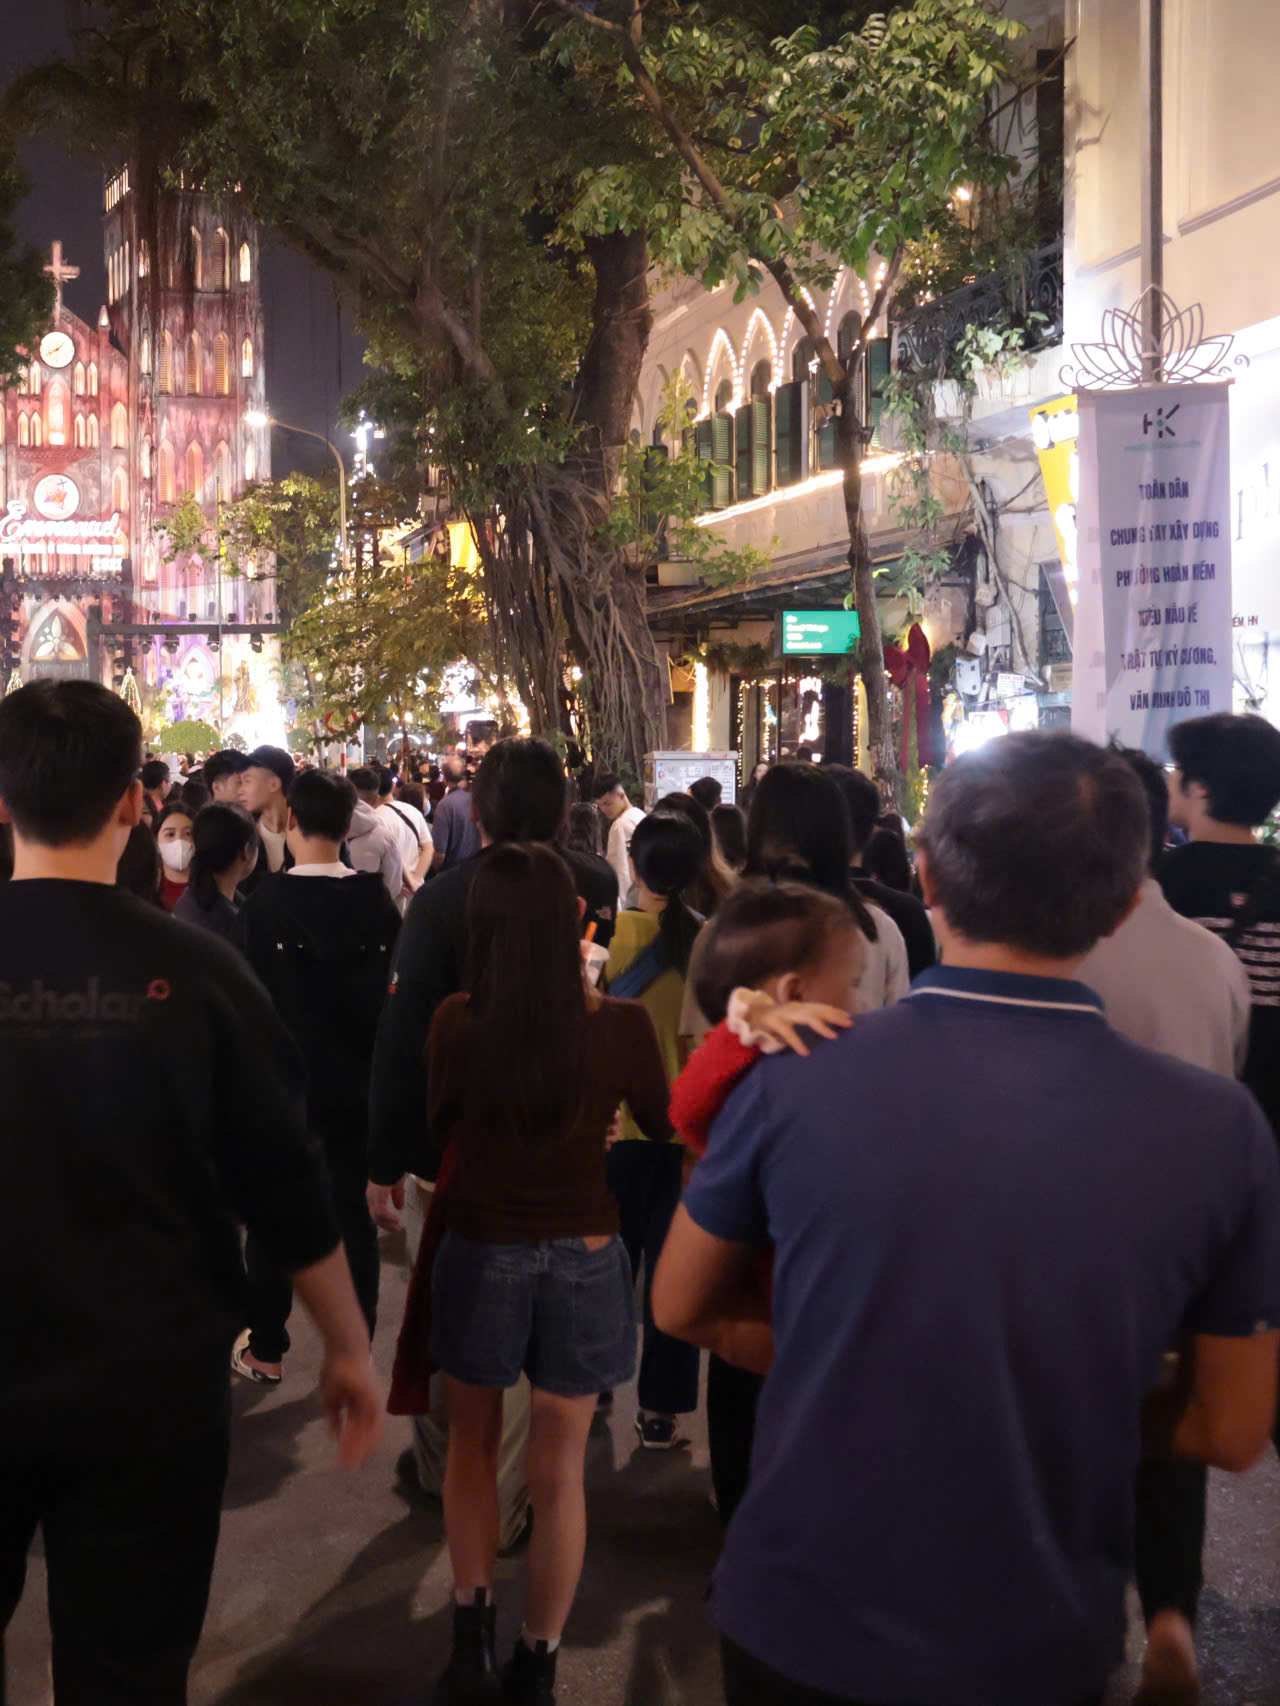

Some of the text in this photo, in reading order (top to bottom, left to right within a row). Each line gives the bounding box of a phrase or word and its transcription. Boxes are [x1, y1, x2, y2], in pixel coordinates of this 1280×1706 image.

[1138, 477, 1189, 500] TOÀN DÂN
[1110, 520, 1219, 546] CHUNG TAY XÂY DỰNG
[1116, 564, 1161, 587] PHỜNG
[1129, 690, 1149, 711] VĂN
[1194, 689, 1210, 710] THỊ
